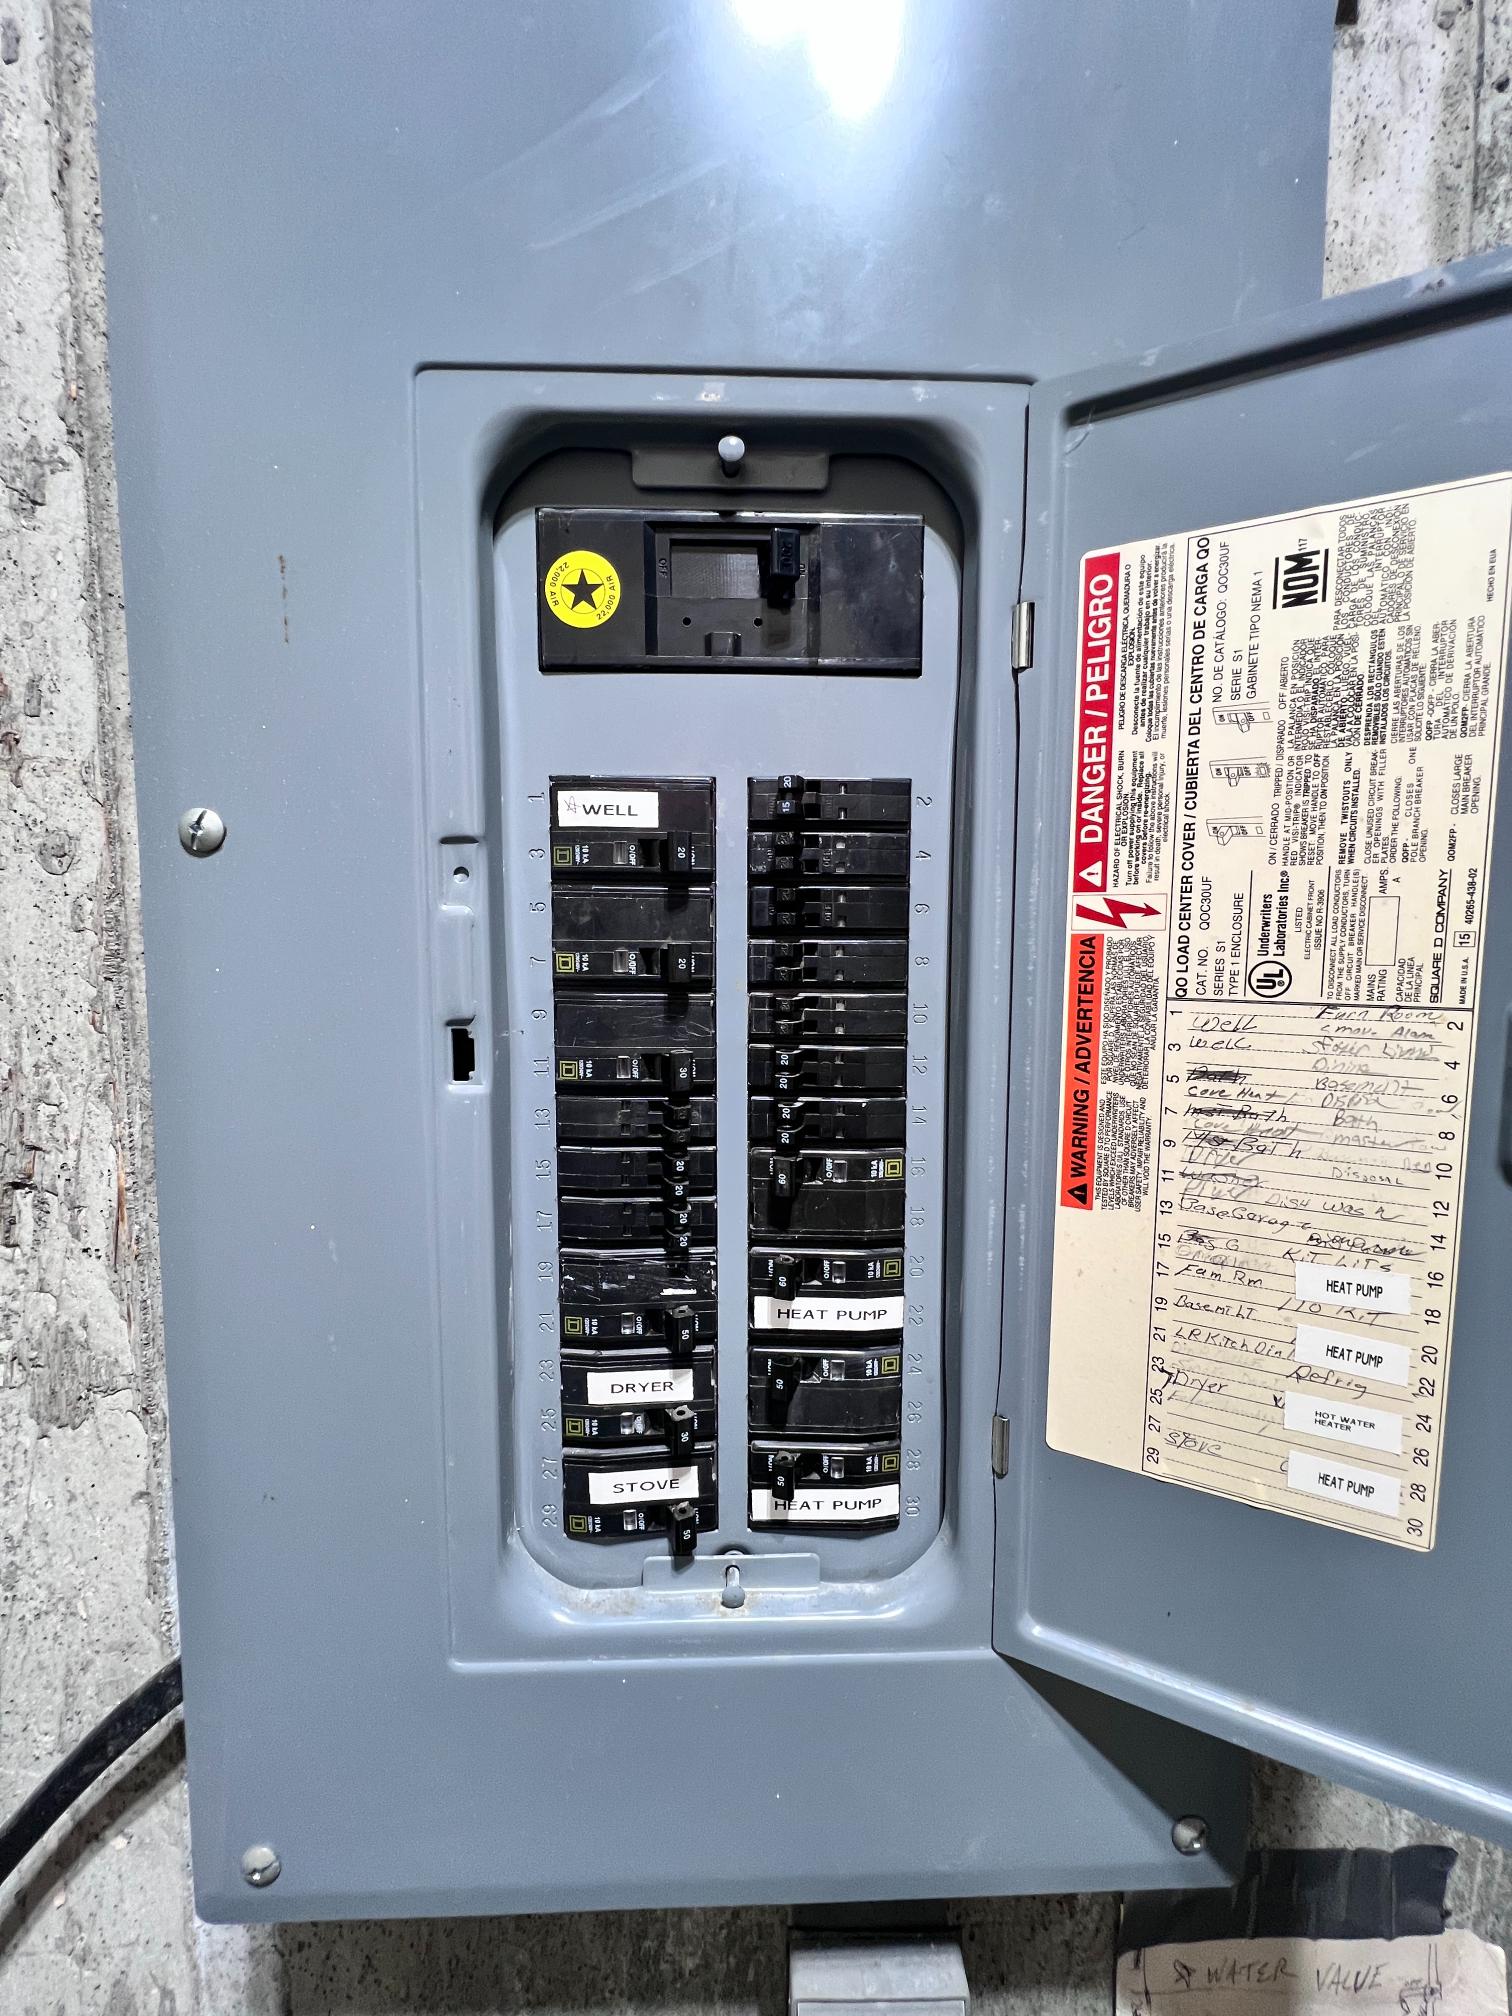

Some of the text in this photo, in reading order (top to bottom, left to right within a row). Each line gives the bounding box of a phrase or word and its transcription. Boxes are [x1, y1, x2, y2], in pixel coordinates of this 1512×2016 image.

[1197, 537, 1209, 559] QO
[1282, 538, 1320, 608] NOM 117
[550, 562, 570, 607] 22,000 AIR
[1193, 563, 1208, 616] CARGA
[596, 575, 616, 620] 22,000 AIR
[1252, 579, 1262, 611] NEMA
[1193, 620, 1206, 639] DE
[1212, 541, 1229, 703] NO. DE CATÁLOGO: QOC30UF
[1250, 614, 1260, 640] TIPO
[1190, 644, 1205, 703] CENTRO
[1230, 649, 1242, 700] SERIE S1
[1246, 643, 1259, 699] GABINETE
[1080, 574, 1113, 844] DANGER / PELIGRO
[1189, 707, 1202, 735] DEL
[783, 776, 792, 788] 20
[1185, 739, 1200, 810] CUBIERTA
[528, 792, 545, 803] 1
[782, 801, 790, 813] 15
[916, 796, 932, 808] 2
[582, 804, 638, 816] WELL
[529, 848, 546, 859] 3
[677, 846, 685, 859] 20
[915, 850, 931, 861] 4
[1182, 822, 1196, 871] COVER
[1379, 867, 1388, 894] AMPS.
[1179, 875, 1193, 931] CENTER
[1465, 868, 1477, 925] 40265-438-02
[530, 902, 547, 913] 5
[914, 903, 930, 914] 6
[1231, 893, 1243, 958] ENCLOSURE
[1257, 894, 1272, 956] Underwriters
[1273, 896, 1289, 956] Laboratories
[1295, 907, 1303, 933] LISTED
[1196, 876, 1212, 995] CAT. NO. QOC30UF
[1430, 869, 1448, 1003] SQUARE D COMPANY
[1459, 934, 1470, 945] 15
[530, 956, 546, 968] 7
[914, 956, 930, 967] 8
[1177, 935, 1190, 973] LOAD
[1214, 941, 1225, 996] SERIES S1
[1175, 977, 1187, 998] QO
[1229, 969, 1240, 996] TYPE
[1367, 974, 1376, 1001] MAINS
[1377, 969, 1387, 1001] RATING
[1075, 936, 1096, 1074] ADVERTENCIA
[1459, 986, 1467, 1004] MADE
[531, 1009, 547, 1020] 9
[912, 1003, 928, 1025] 10
[1447, 1021, 1463, 1031] 2
[1168, 1043, 1181, 1051] 3
[534, 1056, 549, 1078] 11
[679, 1067, 687, 1079] 30
[912, 1055, 928, 1076] 12
[1444, 1061, 1460, 1070] 4
[1167, 1075, 1179, 1083] 5
[1442, 1094, 1458, 1104] 6
[534, 1108, 550, 1131] 13
[911, 1106, 927, 1126] 14
[1165, 1107, 1177, 1115] 7
[1070, 1089, 1090, 1179] WARNING
[1439, 1132, 1455, 1140] 8
[536, 1159, 552, 1182] 15
[910, 1157, 926, 1178] 16
[1162, 1170, 1174, 1182] 11
[1436, 1163, 1452, 1180] 10
[909, 1207, 925, 1228] 18
[1160, 1201, 1173, 1215] 13
[1433, 1201, 1449, 1218] 12
[536, 1210, 553, 1232] 17
[1158, 1234, 1171, 1248] 15
[1430, 1234, 1446, 1251] 14
[538, 1261, 553, 1283] 19
[909, 1255, 924, 1278] 20
[1154, 1262, 1170, 1276] 17
[779, 1276, 787, 1287] 60
[1326, 1280, 1383, 1298] HEAT PUMP
[1427, 1272, 1444, 1288] 16
[777, 1308, 888, 1320] HEAT PUMP
[1155, 1297, 1167, 1312] 19
[539, 1310, 554, 1333] 21
[908, 1304, 923, 1326] 22
[1425, 1309, 1441, 1325] 18
[681, 1329, 690, 1340] 50
[1153, 1327, 1166, 1342] 21
[907, 1353, 922, 1376] 24
[1152, 1357, 1164, 1373] 23
[1326, 1345, 1383, 1368] HEAT PUMP
[1421, 1346, 1438, 1364] 20
[539, 1359, 554, 1382] 23
[610, 1381, 674, 1394] DRYER
[1150, 1388, 1163, 1405] 25
[1419, 1377, 1435, 1397] 22
[541, 1408, 557, 1432] 25
[907, 1400, 923, 1424] 26
[1315, 1411, 1375, 1429] HOT WATER
[1148, 1416, 1161, 1432] 27
[1314, 1418, 1351, 1432] HEATER
[1416, 1414, 1432, 1433] 24
[907, 1448, 921, 1471] 28
[1147, 1447, 1159, 1464] 29
[1413, 1448, 1430, 1467] 26
[541, 1457, 558, 1480] 27
[612, 1478, 680, 1494] STOVE
[1318, 1472, 1375, 1498] HEAT PUMP
[1410, 1483, 1426, 1502] 28
[774, 1498, 882, 1510] HEAT PUMP
[905, 1496, 920, 1517] 30
[542, 1504, 558, 1528] 29
[683, 1529, 691, 1540] 50
[1407, 1518, 1424, 1537] 30
[1207, 1956, 1297, 1986] WATER
